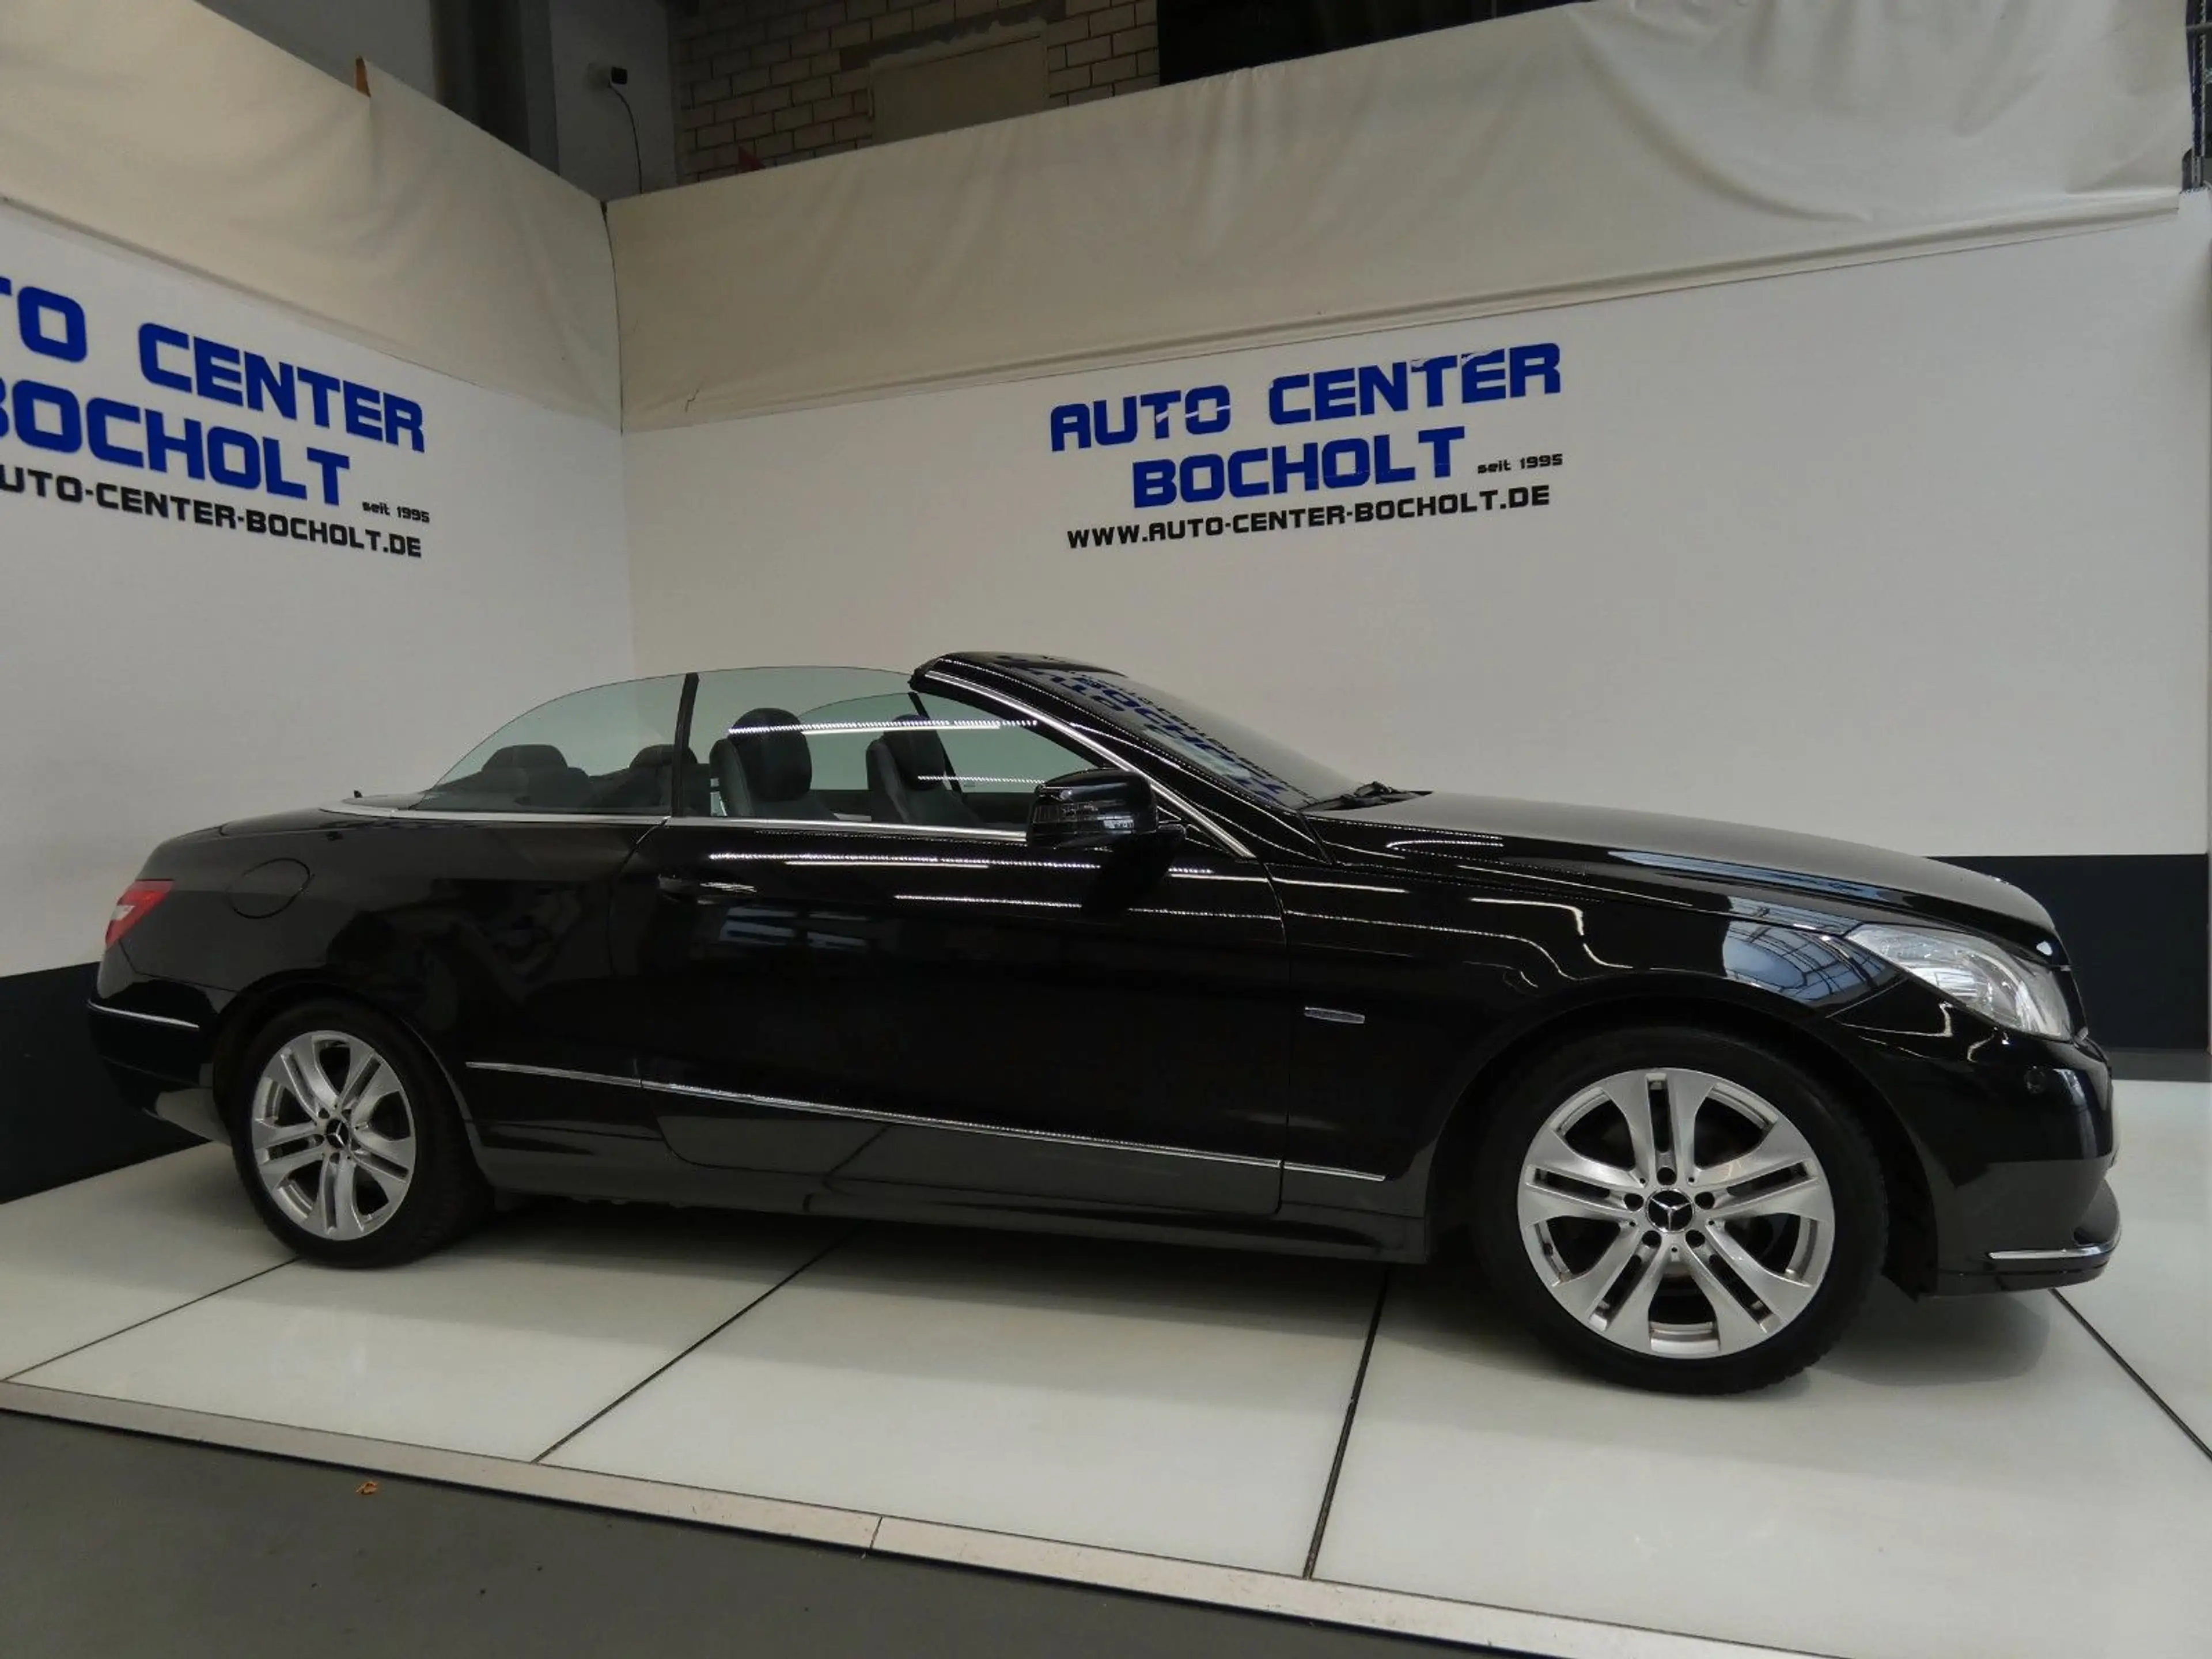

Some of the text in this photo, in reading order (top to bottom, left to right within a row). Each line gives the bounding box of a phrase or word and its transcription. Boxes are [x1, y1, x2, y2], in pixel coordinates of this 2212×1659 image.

[0, 276, 425, 453] O CENTER
[1050, 343, 1560, 451] AUTO CENTER
[0, 378, 350, 506] OCHOLT
[1132, 427, 1465, 508] BOCHOLT
[1478, 453, 1563, 474] seit 1995
[362, 501, 430, 524] seit 1995
[1067, 484, 1550, 549] WWW.AUTO-CENTER-BOCHOLT.DE
